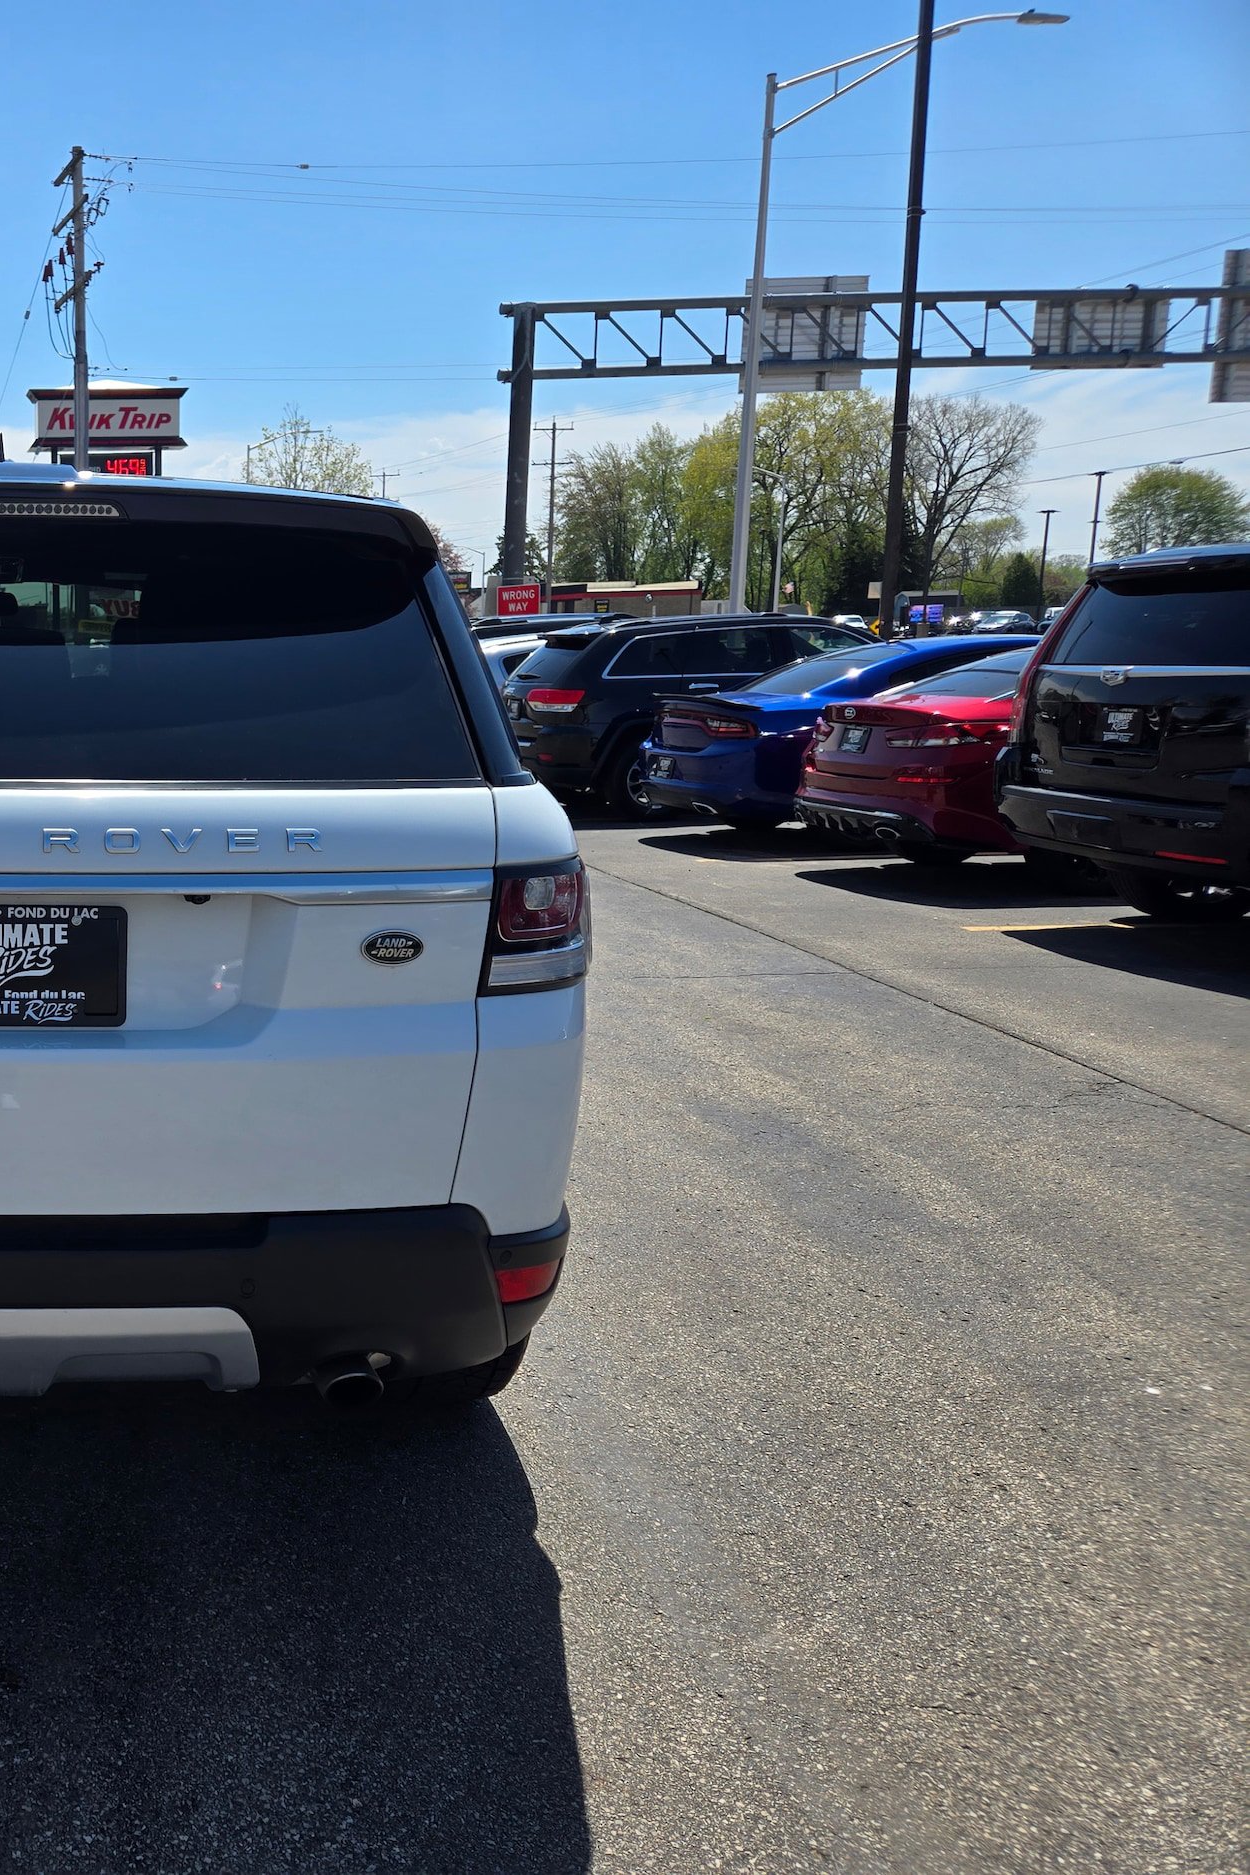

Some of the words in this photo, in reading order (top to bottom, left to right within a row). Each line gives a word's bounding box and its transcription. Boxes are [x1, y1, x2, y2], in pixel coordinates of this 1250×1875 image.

[47, 407, 116, 430] KIK
[118, 407, 172, 430] TRIP
[502, 590, 535, 600] WRONG
[508, 602, 529, 612] WAY
[42, 827, 323, 853] ROVER
[7, 907, 46, 919] FOND
[50, 908, 70, 919] DU
[74, 908, 99, 919] LAC
[376, 938, 406, 947] LAND
[377, 948, 414, 957] ROVER
